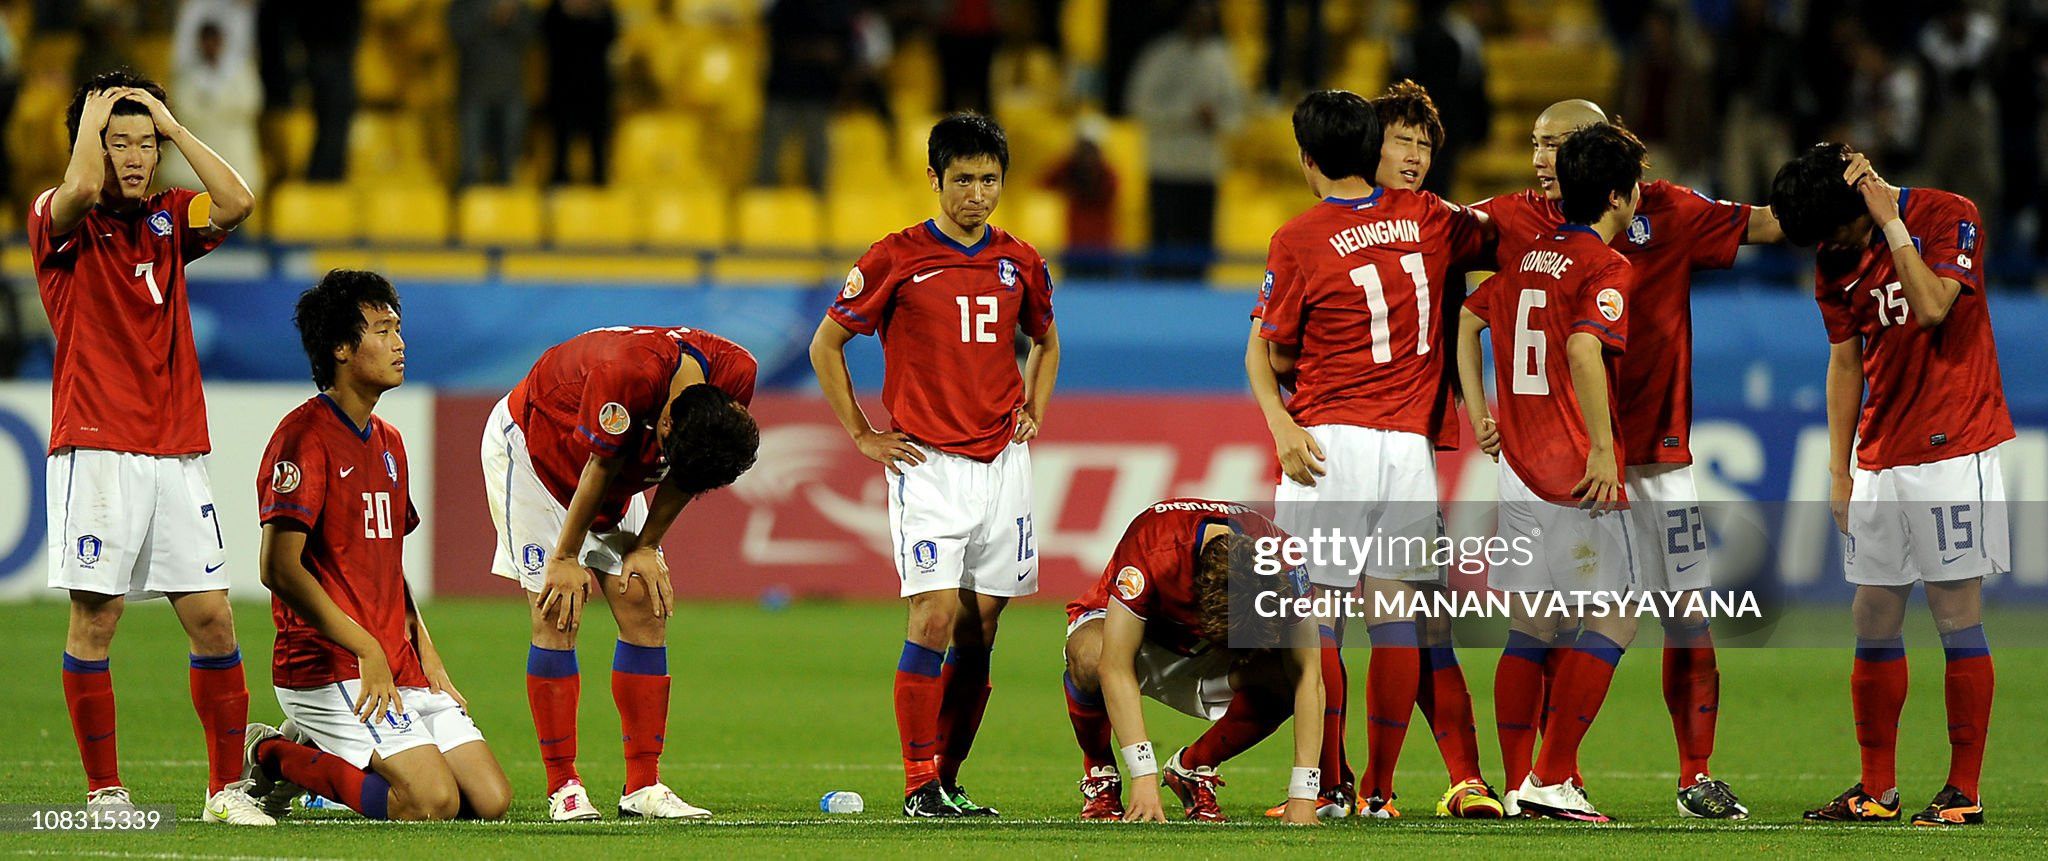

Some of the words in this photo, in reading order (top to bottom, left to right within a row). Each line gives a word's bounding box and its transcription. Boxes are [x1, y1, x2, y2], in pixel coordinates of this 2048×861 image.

[1328, 219, 1421, 258] HEUNGMIN
[135, 262, 163, 304] 7
[1870, 281, 1909, 326] 15
[955, 296, 998, 343] 12
[1349, 252, 1430, 364] 11
[1513, 288, 1550, 395] 6
[200, 503, 223, 549] 7
[362, 492, 392, 538] 20
[1016, 512, 1034, 561] 12
[1666, 506, 1706, 554] 22
[1930, 504, 1973, 551] 15
